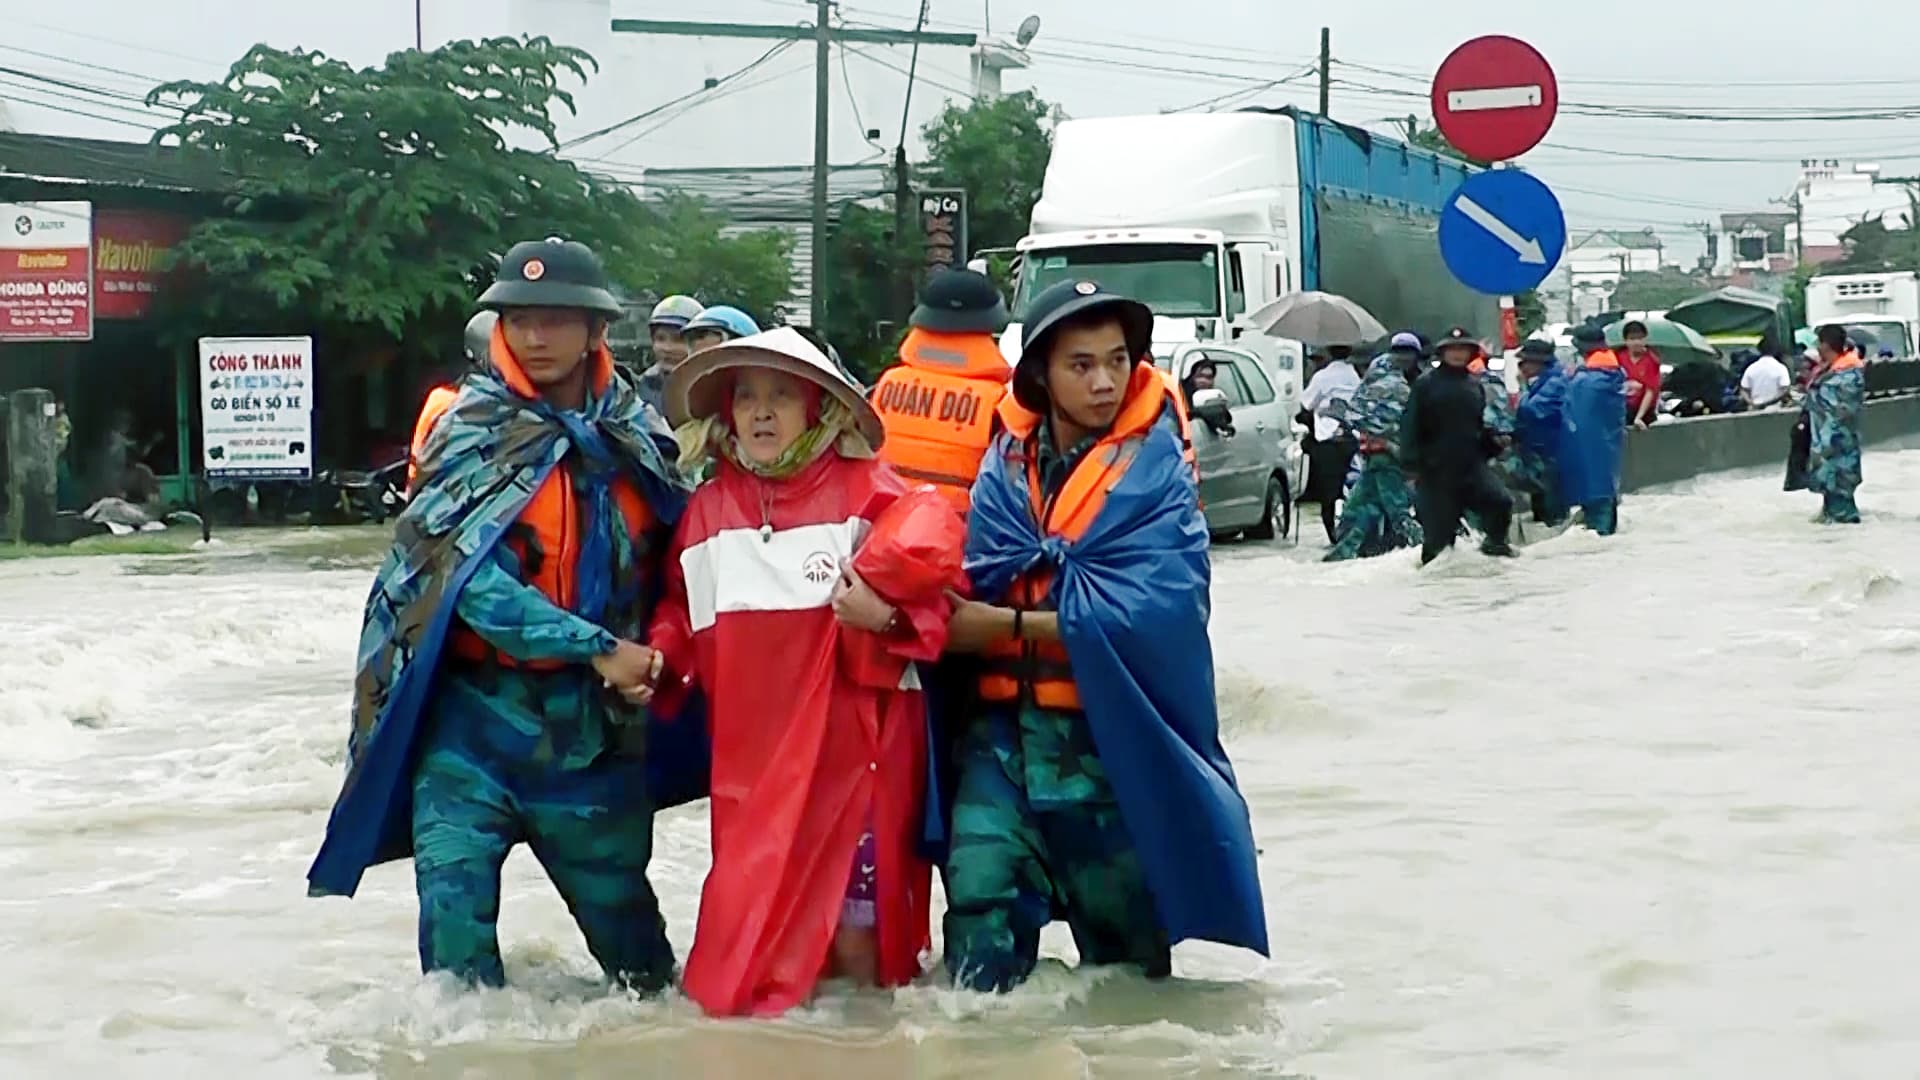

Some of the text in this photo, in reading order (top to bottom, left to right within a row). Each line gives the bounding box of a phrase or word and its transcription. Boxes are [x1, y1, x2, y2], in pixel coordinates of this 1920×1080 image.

[97, 237, 171, 273] Havoli
[286, 396, 302, 408] XE
[880, 378, 937, 420] QUÂN
